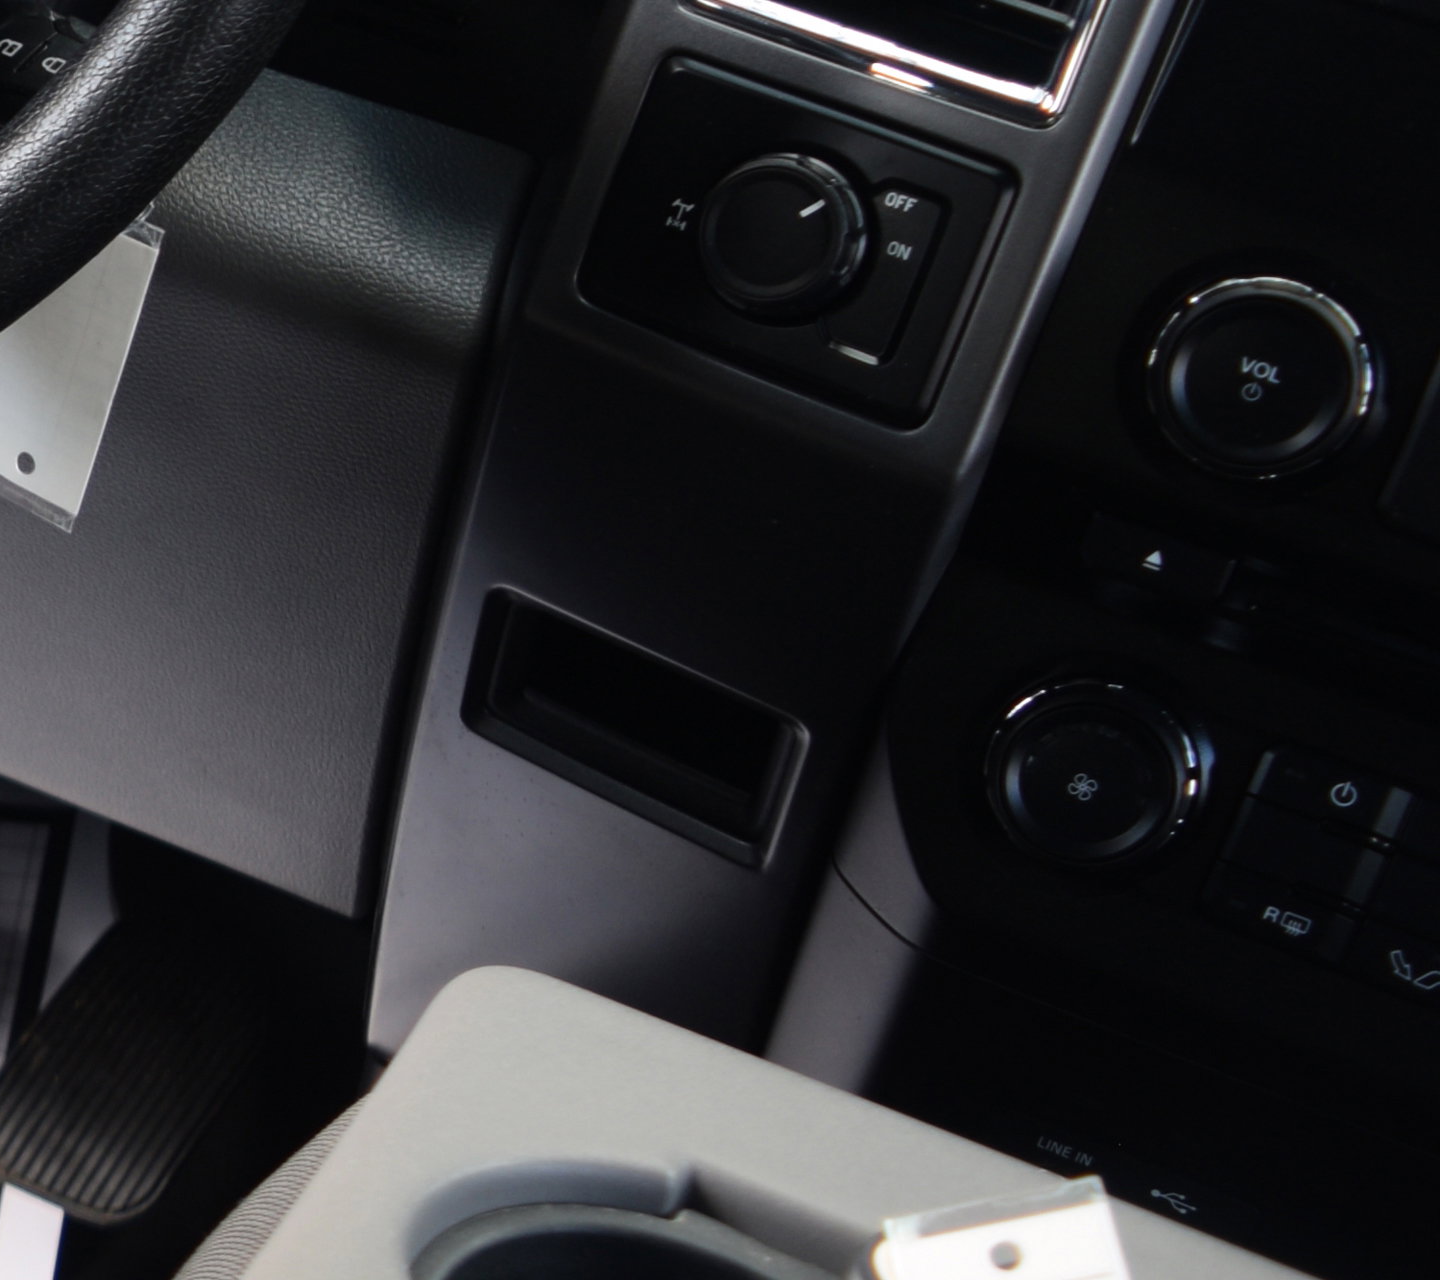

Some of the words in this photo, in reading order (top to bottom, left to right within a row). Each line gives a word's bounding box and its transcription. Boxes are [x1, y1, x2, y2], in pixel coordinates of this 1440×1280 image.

[884, 191, 918, 213] OFF
[886, 241, 913, 261] ON
[1240, 356, 1280, 385] VOL
[1037, 1135, 1073, 1160] LINE
[1074, 1151, 1094, 1167] IN
